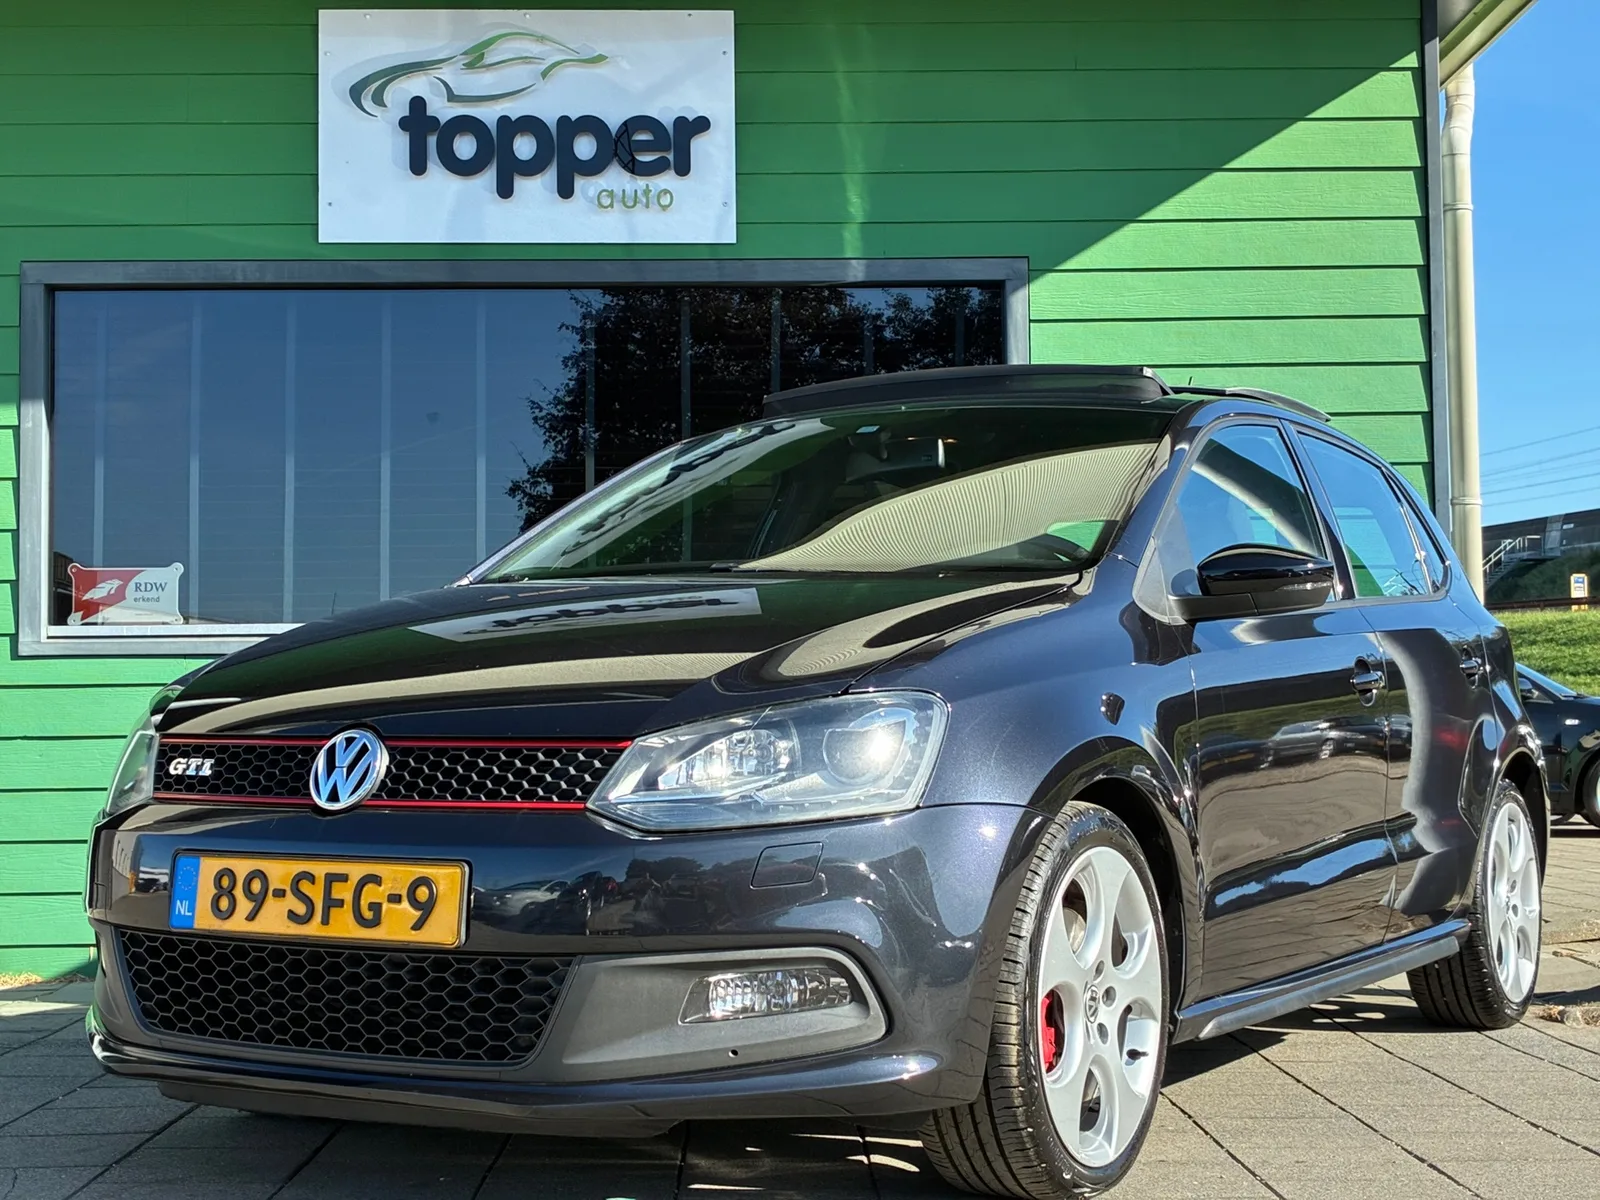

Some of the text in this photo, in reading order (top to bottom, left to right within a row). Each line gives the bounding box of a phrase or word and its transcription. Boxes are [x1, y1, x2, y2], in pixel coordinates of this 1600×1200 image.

[398, 95, 711, 200] topper
[597, 184, 675, 211] auto
[134, 581, 167, 593] RDW
[133, 595, 160, 603] erkend
[168, 757, 215, 777] GTI
[175, 898, 192, 916] NL
[210, 867, 437, 931] 89-SFG-9
